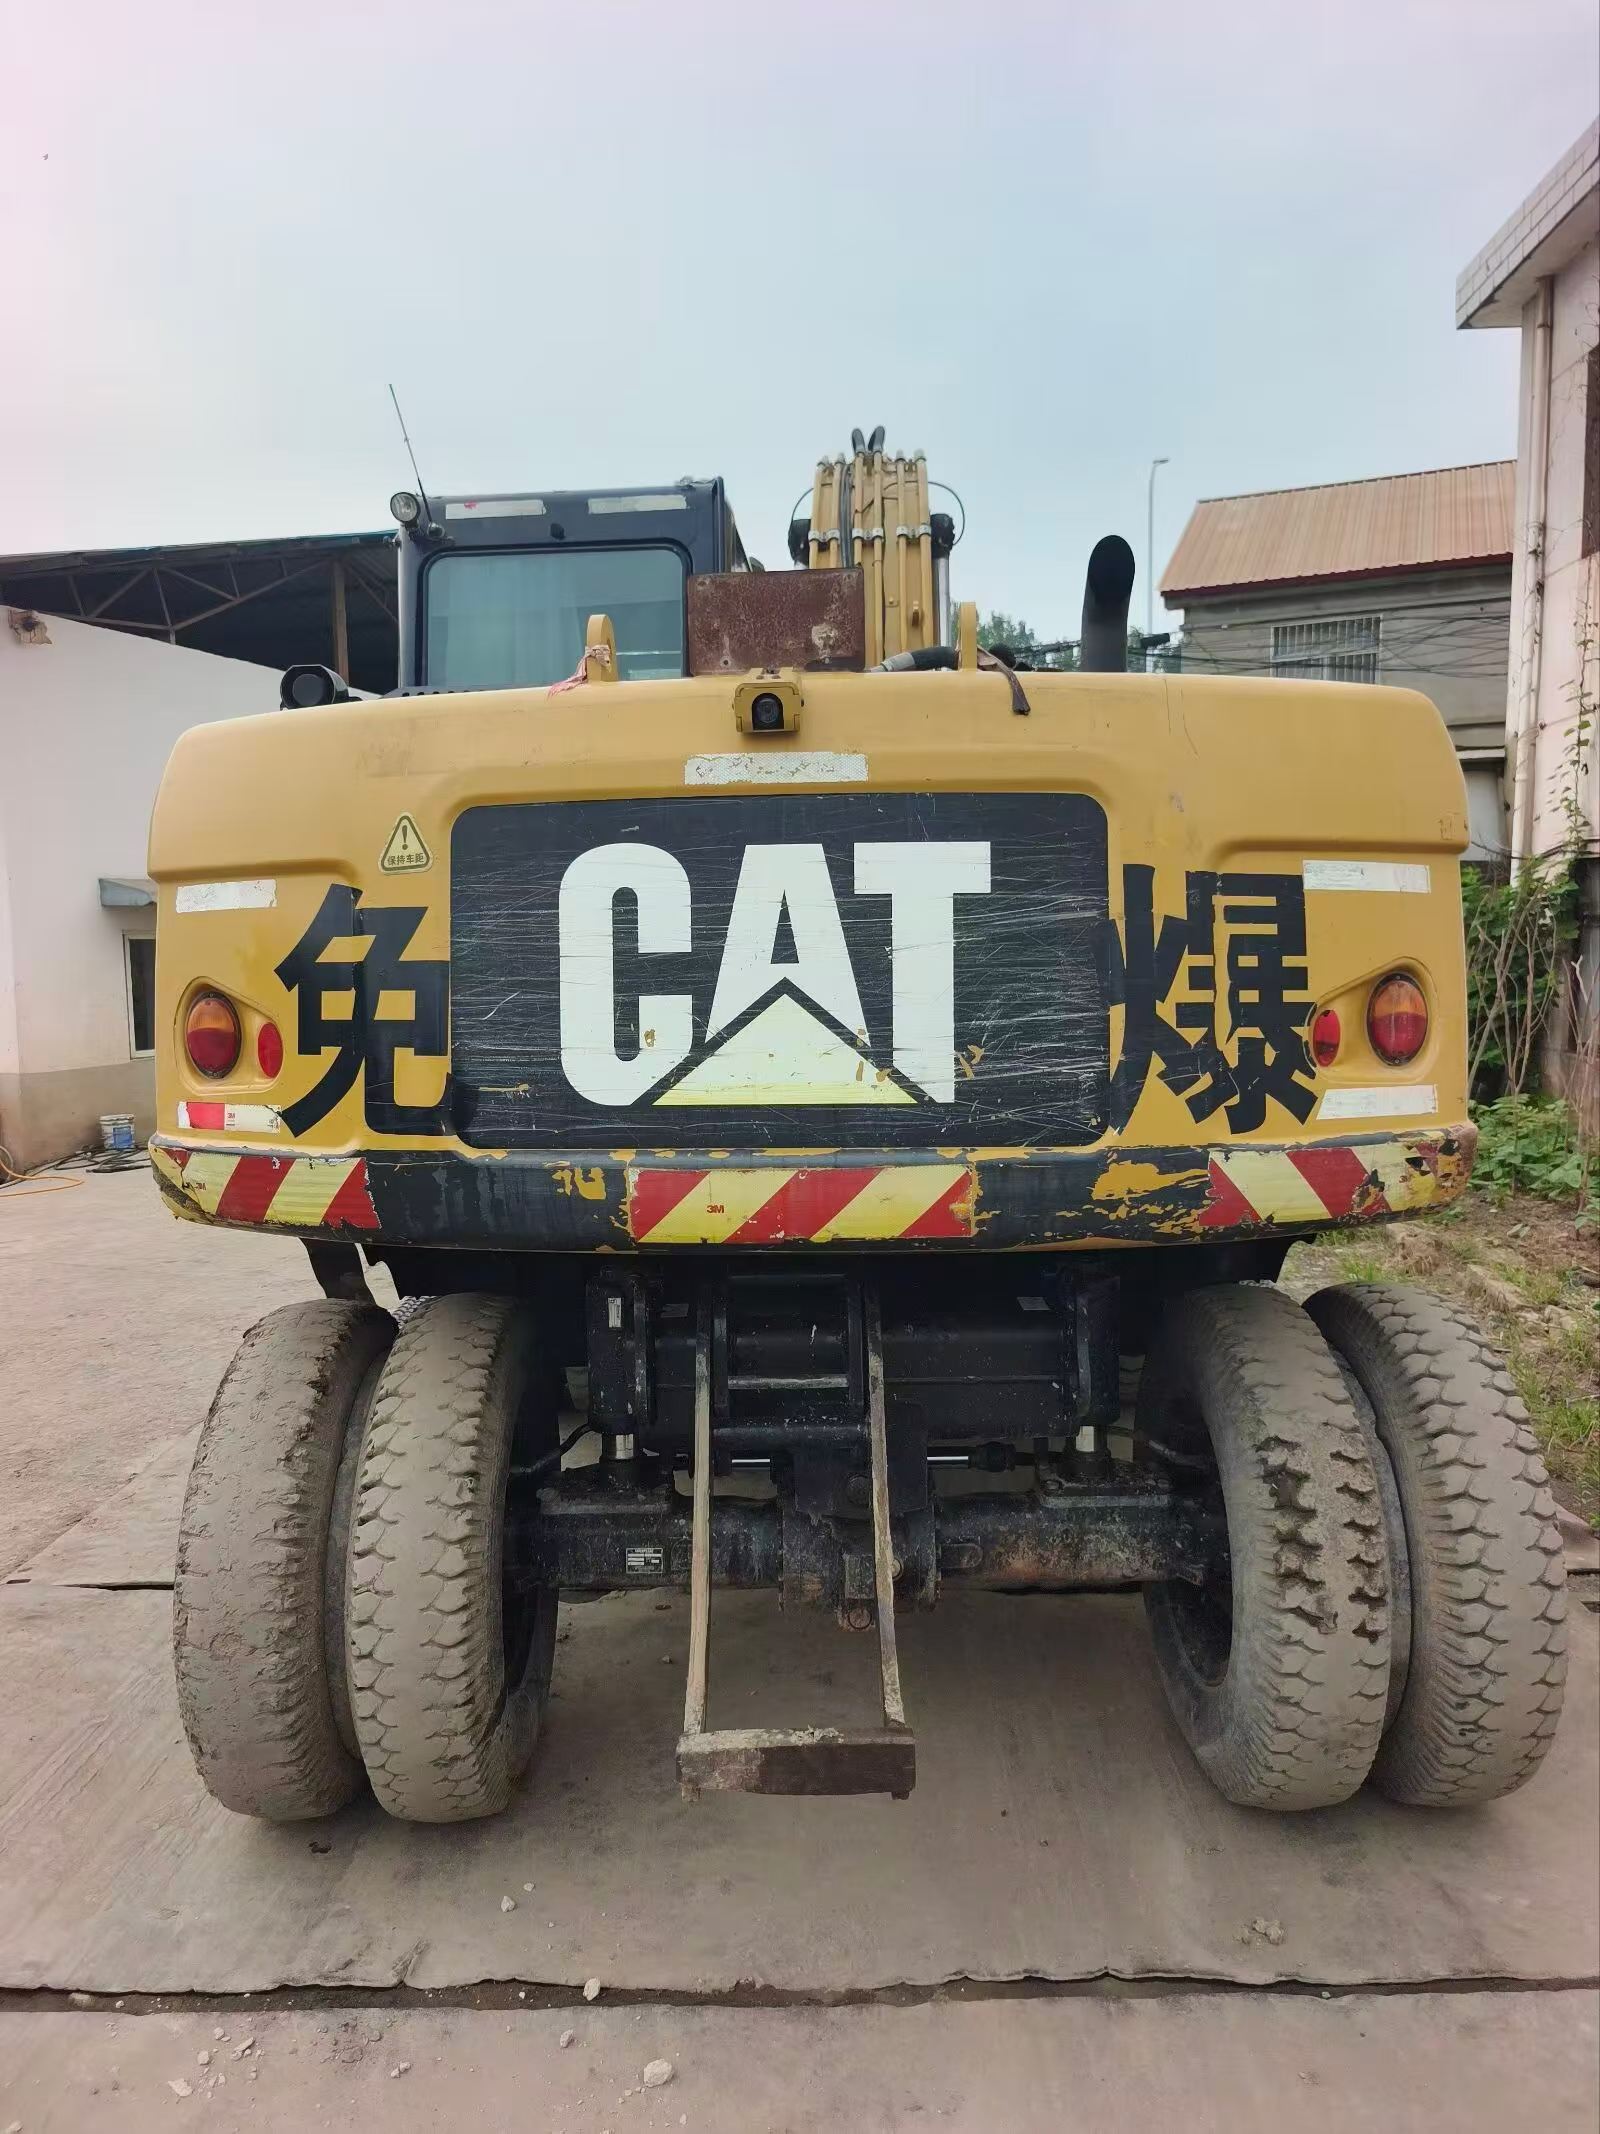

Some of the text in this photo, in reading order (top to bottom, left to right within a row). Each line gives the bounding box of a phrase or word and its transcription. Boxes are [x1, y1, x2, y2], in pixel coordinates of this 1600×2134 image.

[387, 852, 425, 866] 保持车距
[559, 841, 991, 1106] CAT
[274, 883, 455, 1138] 免
[1098, 863, 1319, 1135] 爆
[706, 1204, 725, 1214] 3M
